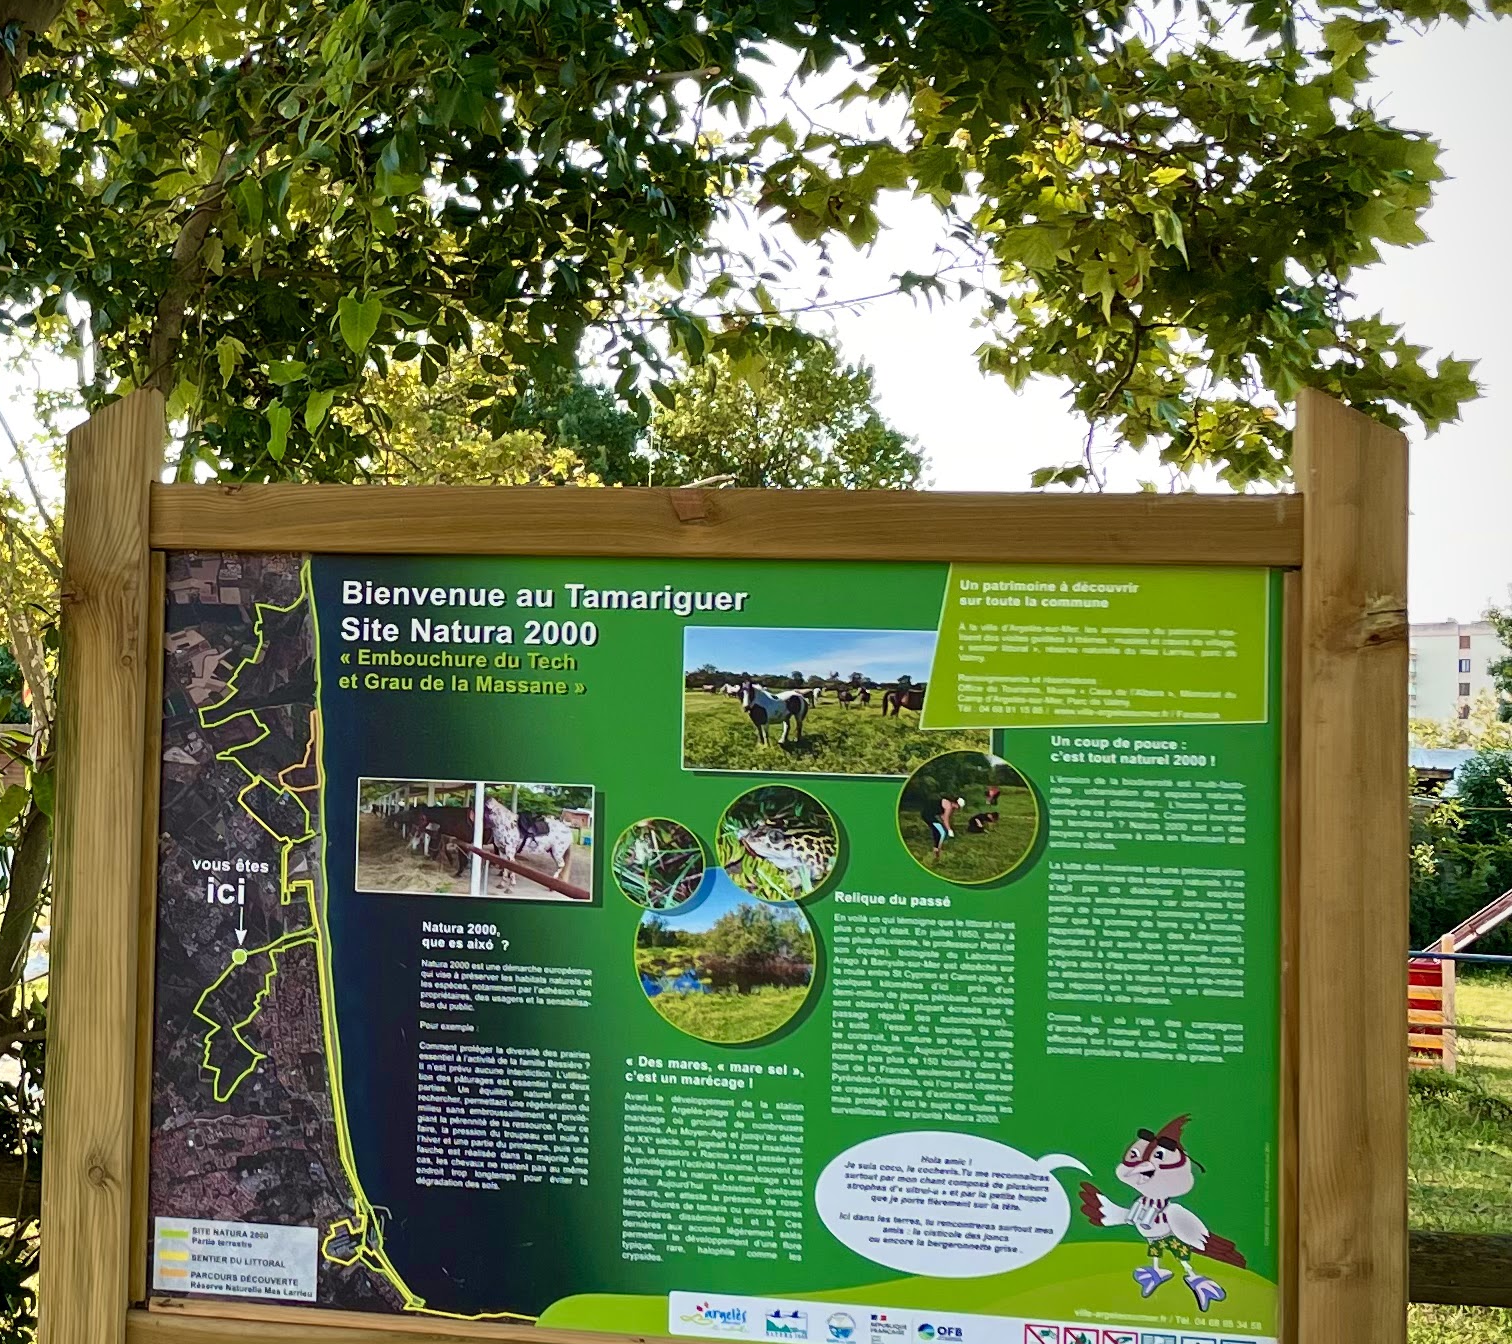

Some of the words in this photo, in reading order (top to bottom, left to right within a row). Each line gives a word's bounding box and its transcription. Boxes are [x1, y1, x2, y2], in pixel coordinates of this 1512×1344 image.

[959, 579, 979, 590] Un
[981, 580, 1056, 592] patrimoine
[1059, 580, 1068, 592] à
[1071, 581, 1139, 593] découvrir
[342, 580, 505, 606] Bienvenue
[515, 588, 553, 607] au
[564, 583, 748, 615] Tamariguer
[959, 596, 982, 605] sur
[984, 595, 1021, 606] toute
[1024, 595, 1038, 607] la
[1040, 598, 1109, 608] commune
[340, 616, 399, 642] Site
[410, 617, 512, 643] Natura
[522, 619, 597, 645] 2000
[357, 648, 487, 667] Embouchure
[493, 651, 520, 671] du
[526, 651, 579, 671] Tech
[338, 673, 358, 689] et
[364, 672, 412, 690] Grau
[419, 674, 444, 691] de
[451, 674, 468, 691] la
[475, 675, 568, 695] Massane
[1050, 734, 1071, 746] Un
[1073, 737, 1110, 750] coup
[1111, 736, 1130, 748] de
[1133, 739, 1178, 751] pouce
[1087, 752, 1117, 764] tout
[1119, 753, 1169, 765] naturel
[1172, 754, 1207, 766] 2000
[191, 859, 230, 872] vous
[235, 858, 269, 874] êtes
[206, 876, 245, 905] ici
[834, 890, 886, 905] Relique
[888, 893, 907, 905] du
[909, 895, 951, 907] passé
[422, 920, 464, 934] Natura
[421, 937, 445, 949] que
[448, 939, 463, 948] es
[637, 1055, 663, 1068] Des
[729, 1063, 763, 1074] mare
[767, 1063, 787, 1075] sel
[660, 1074, 677, 1083] un
[191, 1254, 227, 1263] SENTIER
[229, 1256, 242, 1264] DU
[244, 1258, 285, 1268] LITTORAL
[189, 1270, 238, 1281] PARCOURS
[239, 1274, 298, 1286] DÉCOUVERTE
[936, 1325, 962, 1340] OFB
